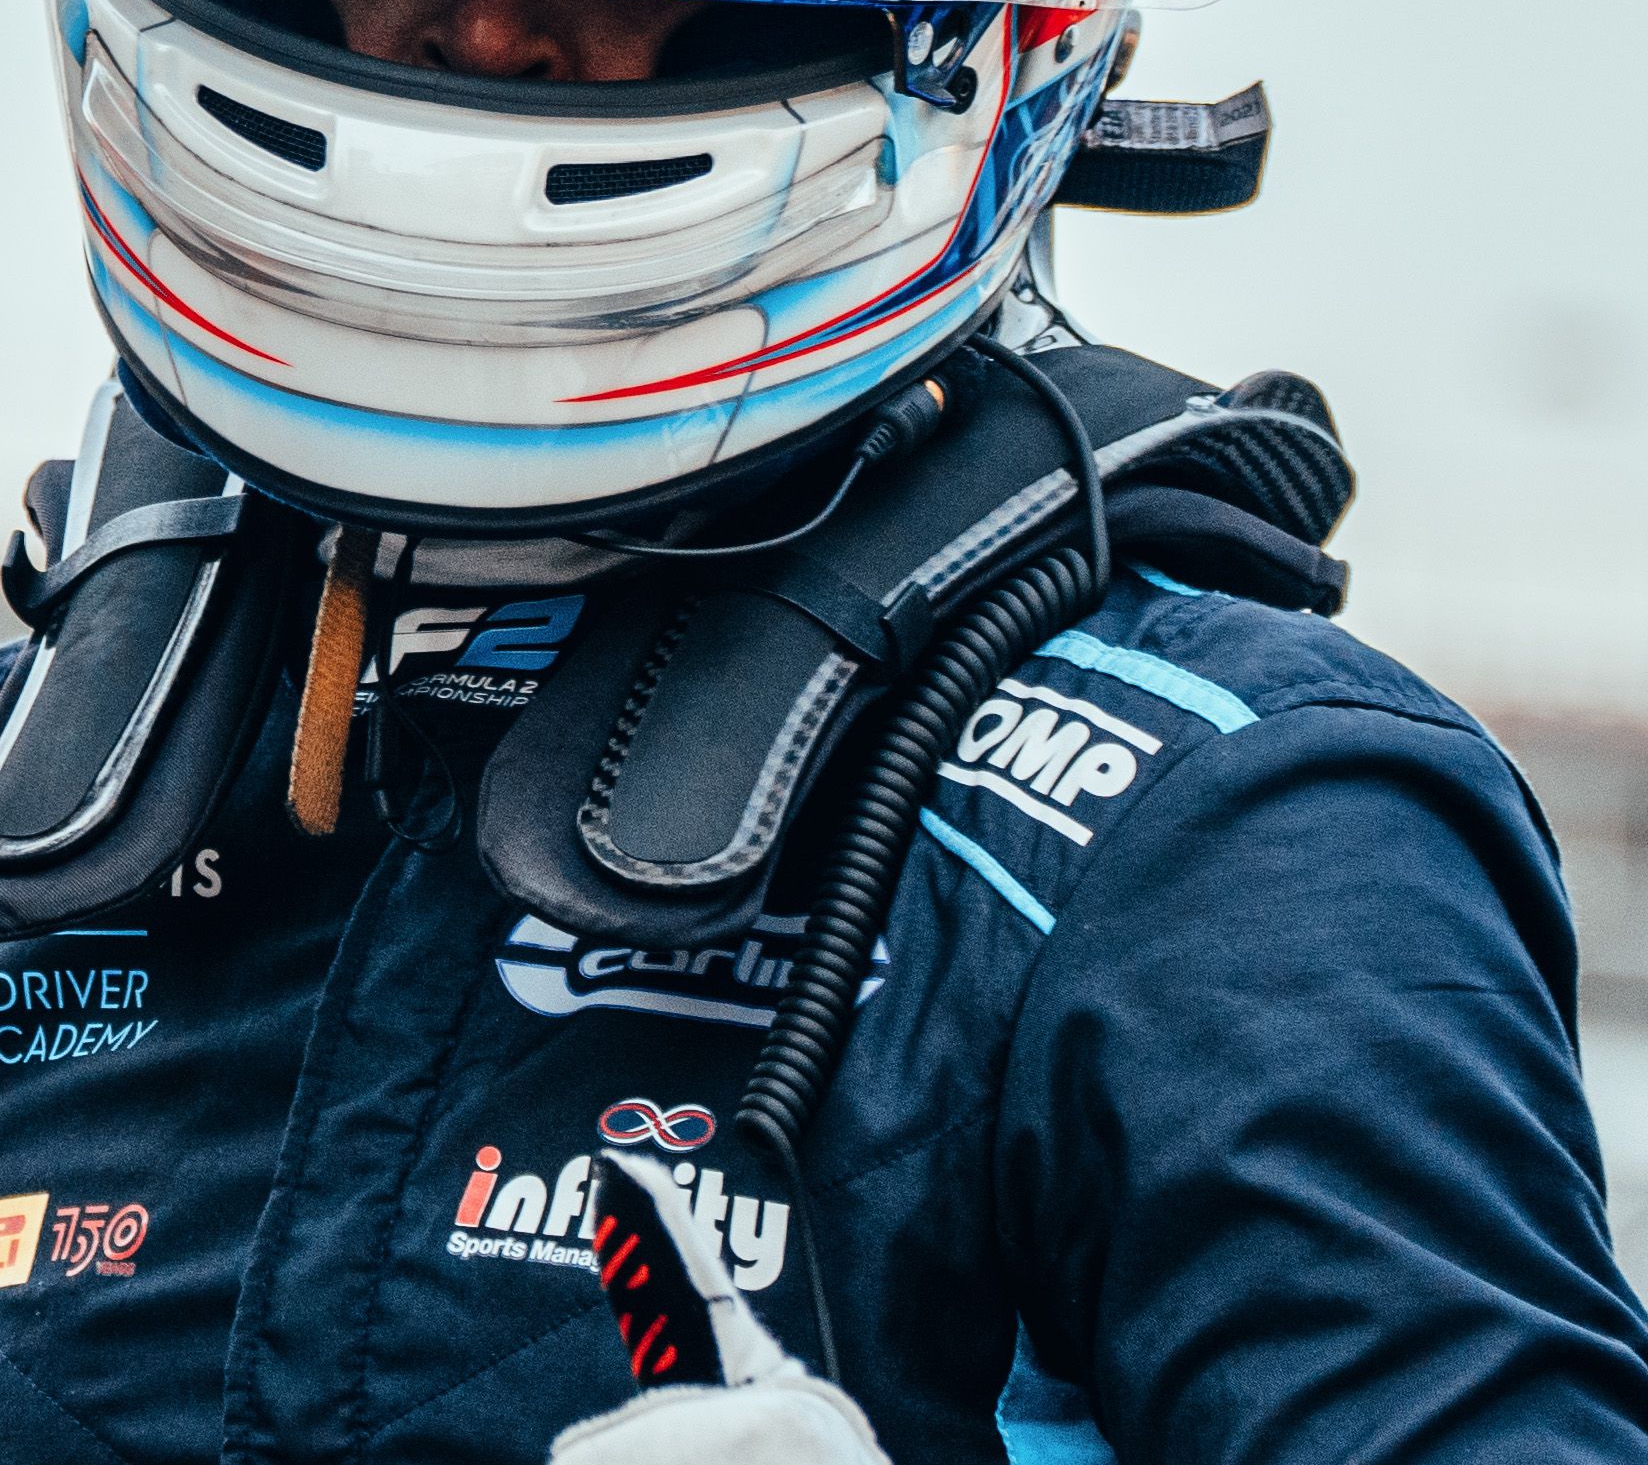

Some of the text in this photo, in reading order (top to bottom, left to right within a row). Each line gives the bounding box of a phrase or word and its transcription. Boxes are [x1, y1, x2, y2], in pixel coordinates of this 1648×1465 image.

[360, 594, 586, 683] F2
[957, 699, 1138, 807] OMP
[51, 1203, 150, 1277] 150
[447, 1230, 528, 1260] Sports
